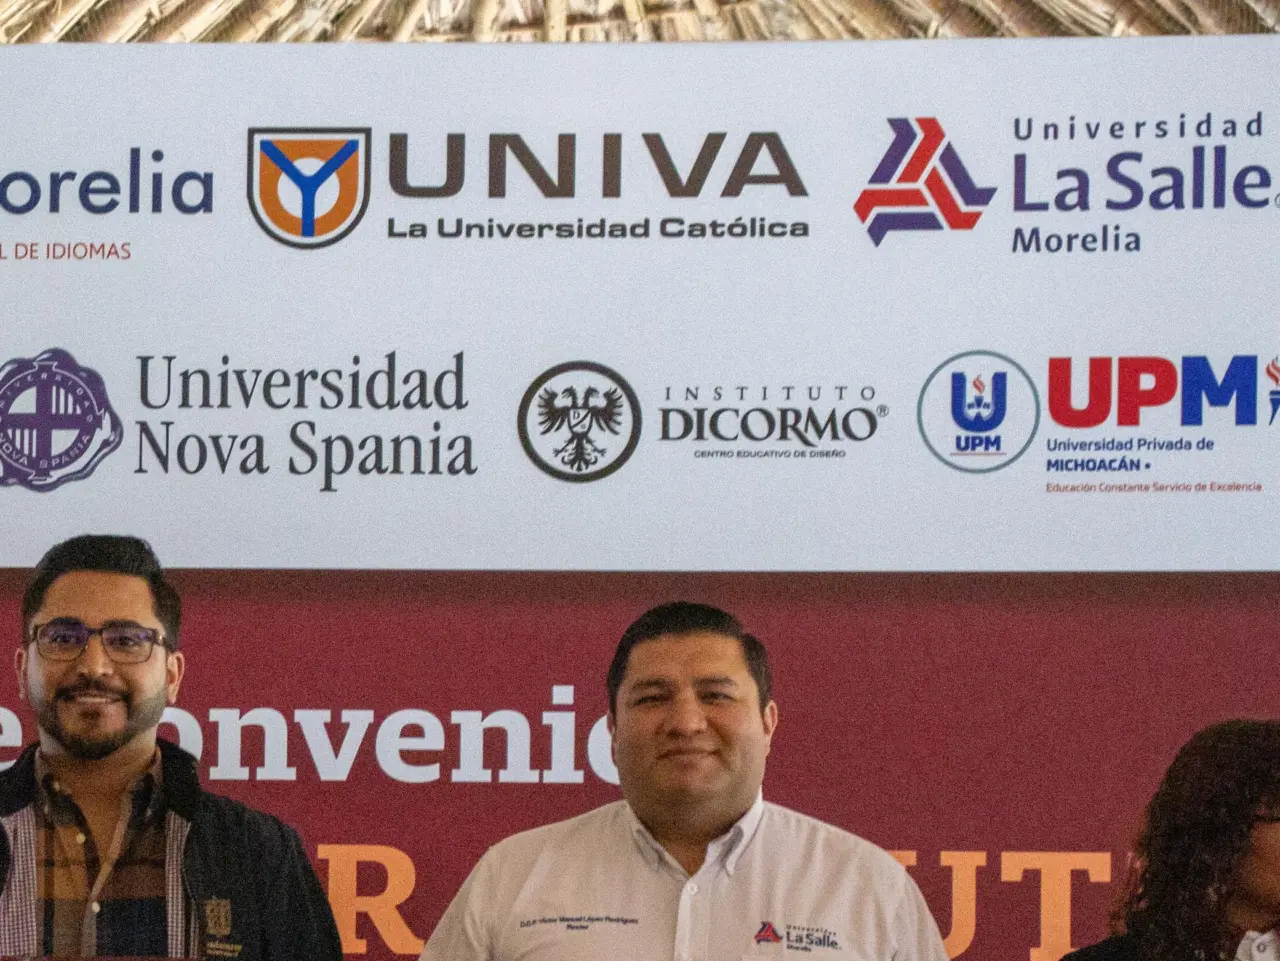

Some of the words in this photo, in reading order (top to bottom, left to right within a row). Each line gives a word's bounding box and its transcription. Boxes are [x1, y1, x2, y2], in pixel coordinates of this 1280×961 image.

[1013, 112, 1263, 140] Universidad
[388, 131, 809, 199] UNIVA
[387, 218, 428, 239] La
[437, 217, 651, 239] Universidad
[659, 216, 810, 239] Católica
[1012, 225, 1141, 253] Morelia
[14, 242, 39, 260] DE
[46, 242, 132, 260] IDIOMAS
[135, 350, 469, 410] Universidad
[1048, 355, 1258, 428] UPM
[665, 386, 876, 401] INSTITUTO
[658, 406, 879, 447] DICORMO
[134, 421, 270, 475] Nova
[288, 419, 478, 492] Spania
[694, 450, 734, 458] CENTRO
[736, 449, 791, 458] EDUCATIVO
[793, 450, 806, 458] DE
[955, 435, 1002, 453] UPM
[1047, 438, 1133, 451] Universidad
[1138, 437, 1193, 451] Privada
[1196, 437, 1215, 450] de
[1046, 456, 1141, 472] MICHOACÁN
[1046, 482, 1096, 493] Educación
[1099, 482, 1150, 493] Constante
[1153, 482, 1192, 492] Servicio
[1195, 482, 1208, 492] de
[1210, 481, 1263, 492] Excelencia
